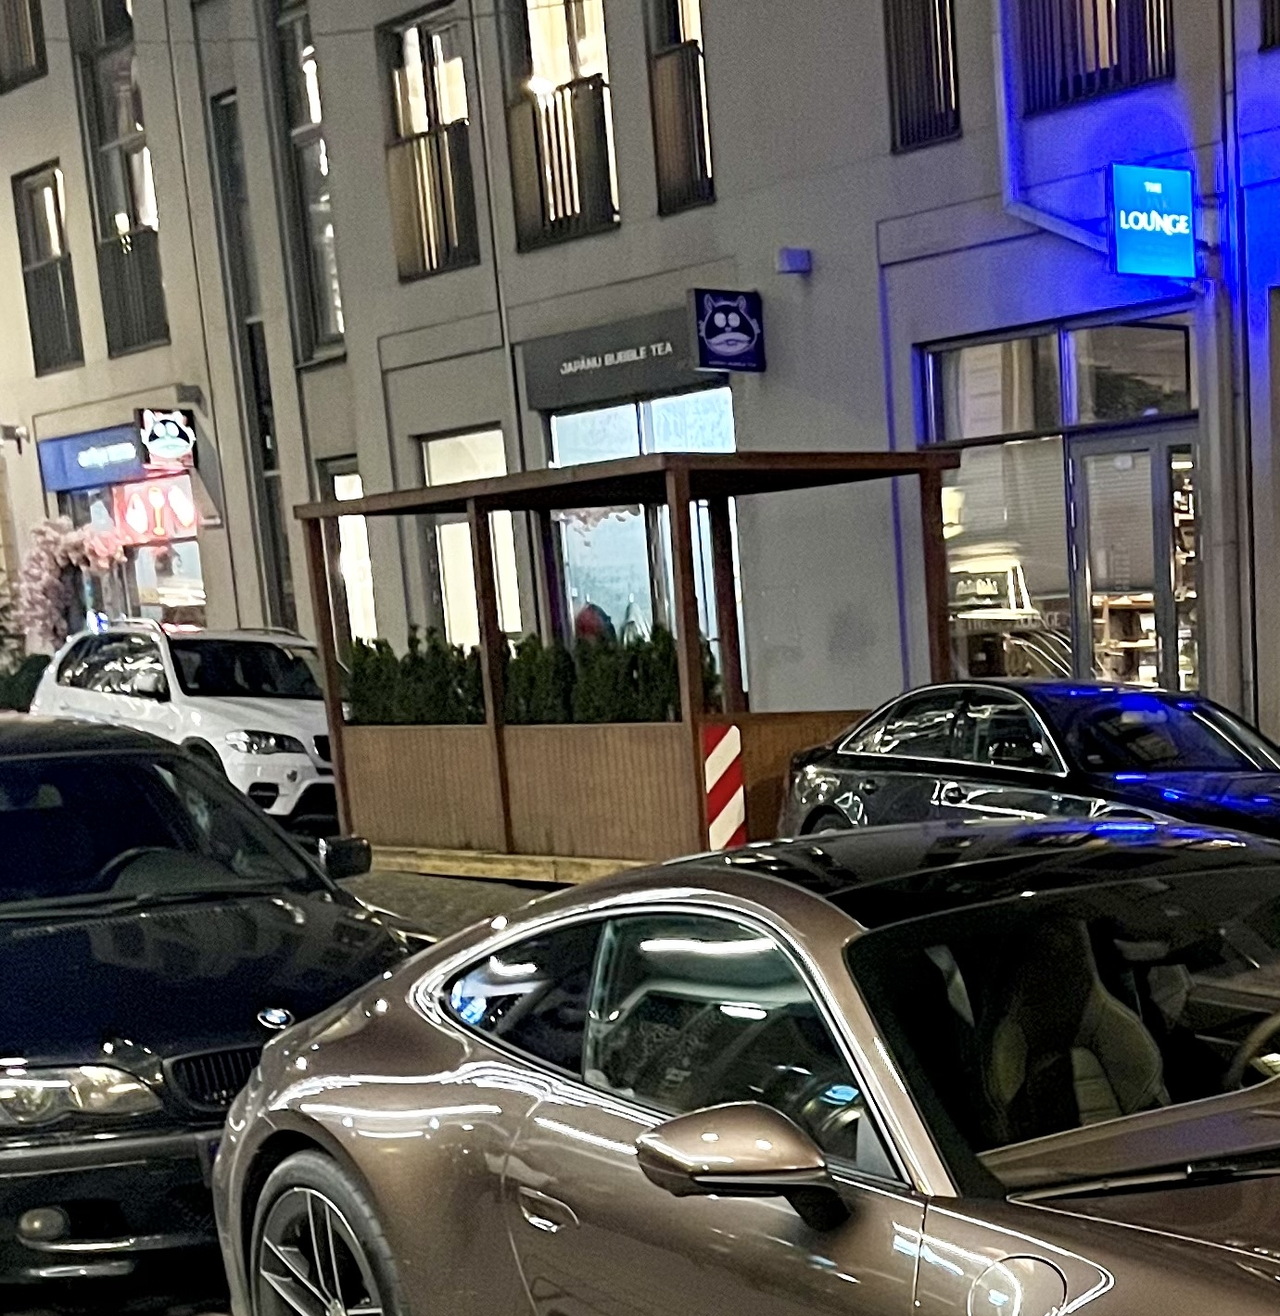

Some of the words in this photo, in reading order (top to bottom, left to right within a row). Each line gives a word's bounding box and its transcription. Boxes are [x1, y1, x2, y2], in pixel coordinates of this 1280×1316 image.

[1119, 209, 1190, 236] LOUNGE
[603, 345, 647, 366] BUBBLE
[650, 341, 673, 357] TEA
